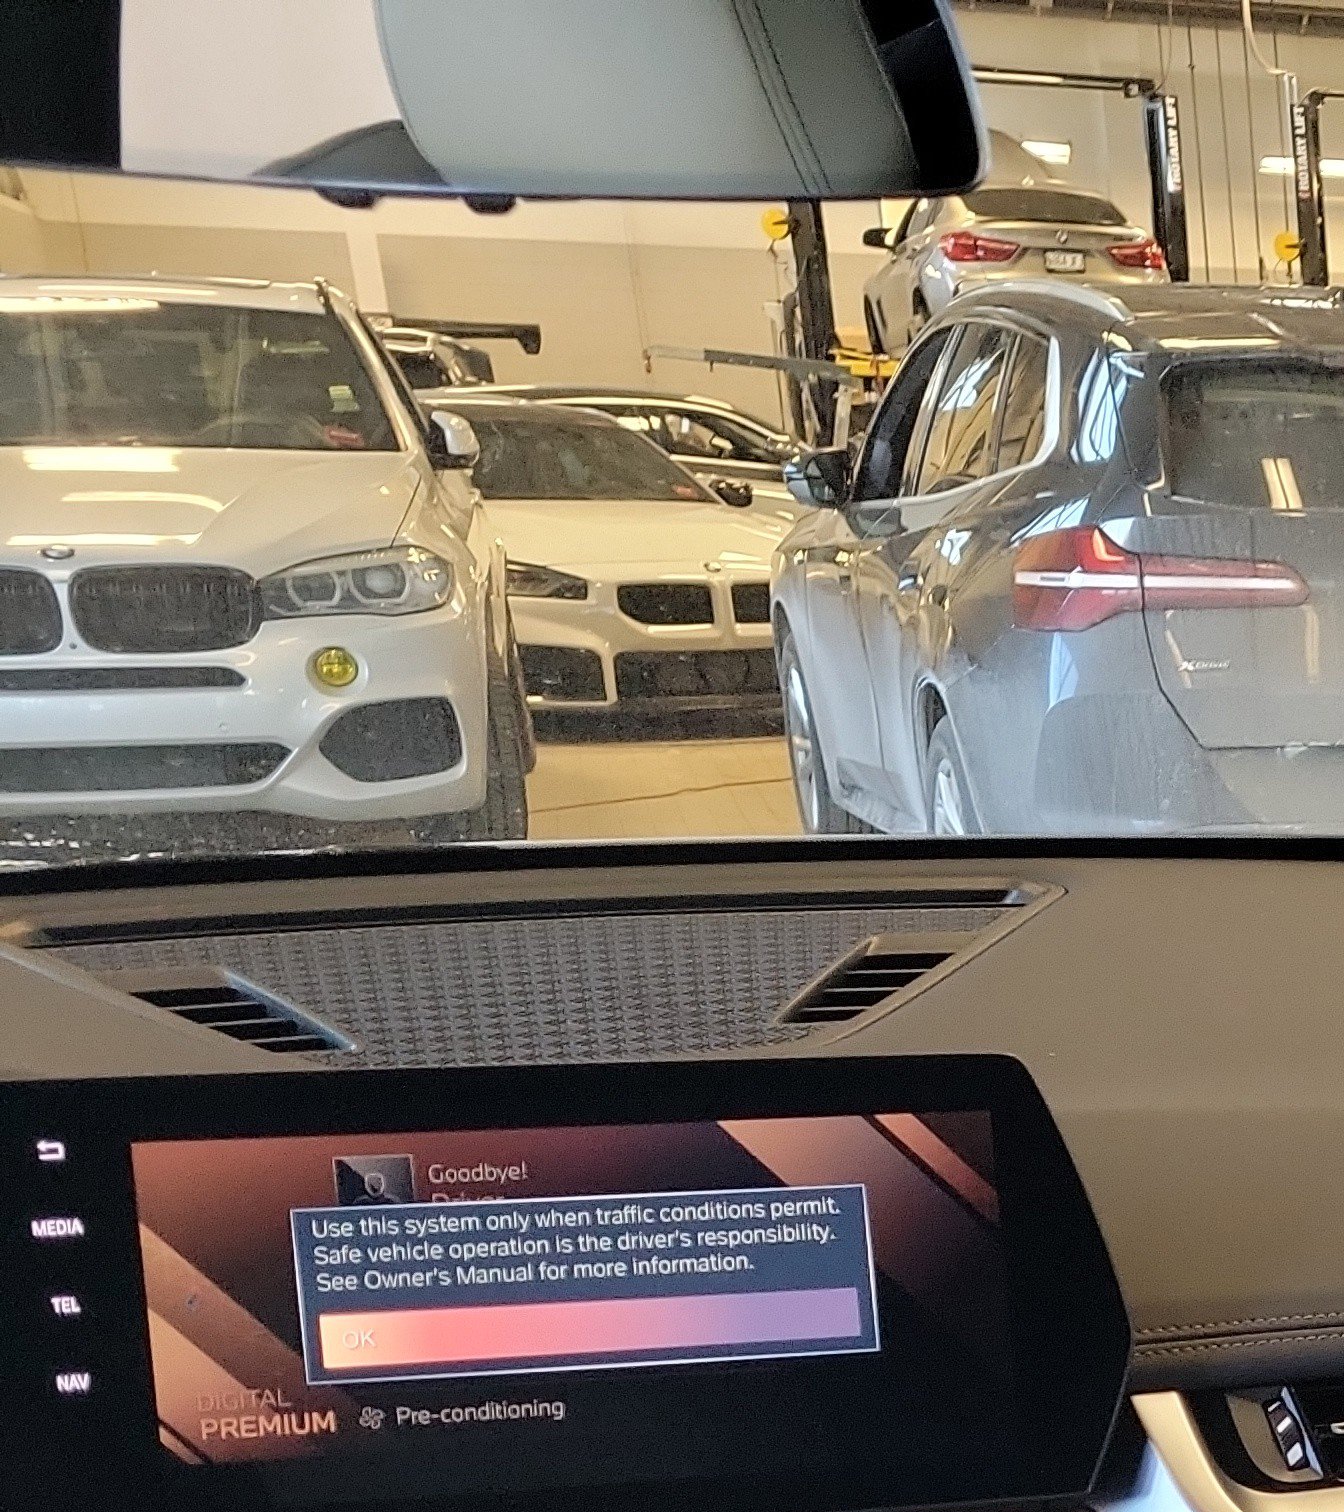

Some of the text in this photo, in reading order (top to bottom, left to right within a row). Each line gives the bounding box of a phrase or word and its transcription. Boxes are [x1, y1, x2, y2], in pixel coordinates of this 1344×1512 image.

[428, 1160, 528, 1184] Goodbye!
[31, 1216, 85, 1238] MEDIA
[311, 1196, 841, 1239] Use this system only when traffic conditions permit.
[313, 1222, 837, 1267] Safe vehicle operation is the driver's responsibility.
[316, 1252, 755, 1293] See Owner's Manual for more information.
[50, 1295, 82, 1316] TEL
[341, 1329, 378, 1351] OK
[55, 1371, 91, 1395] NAV
[197, 1387, 292, 1412] DIGITAL
[199, 1409, 337, 1441] PREMIUM
[396, 1398, 566, 1428] Pre-conditioning
